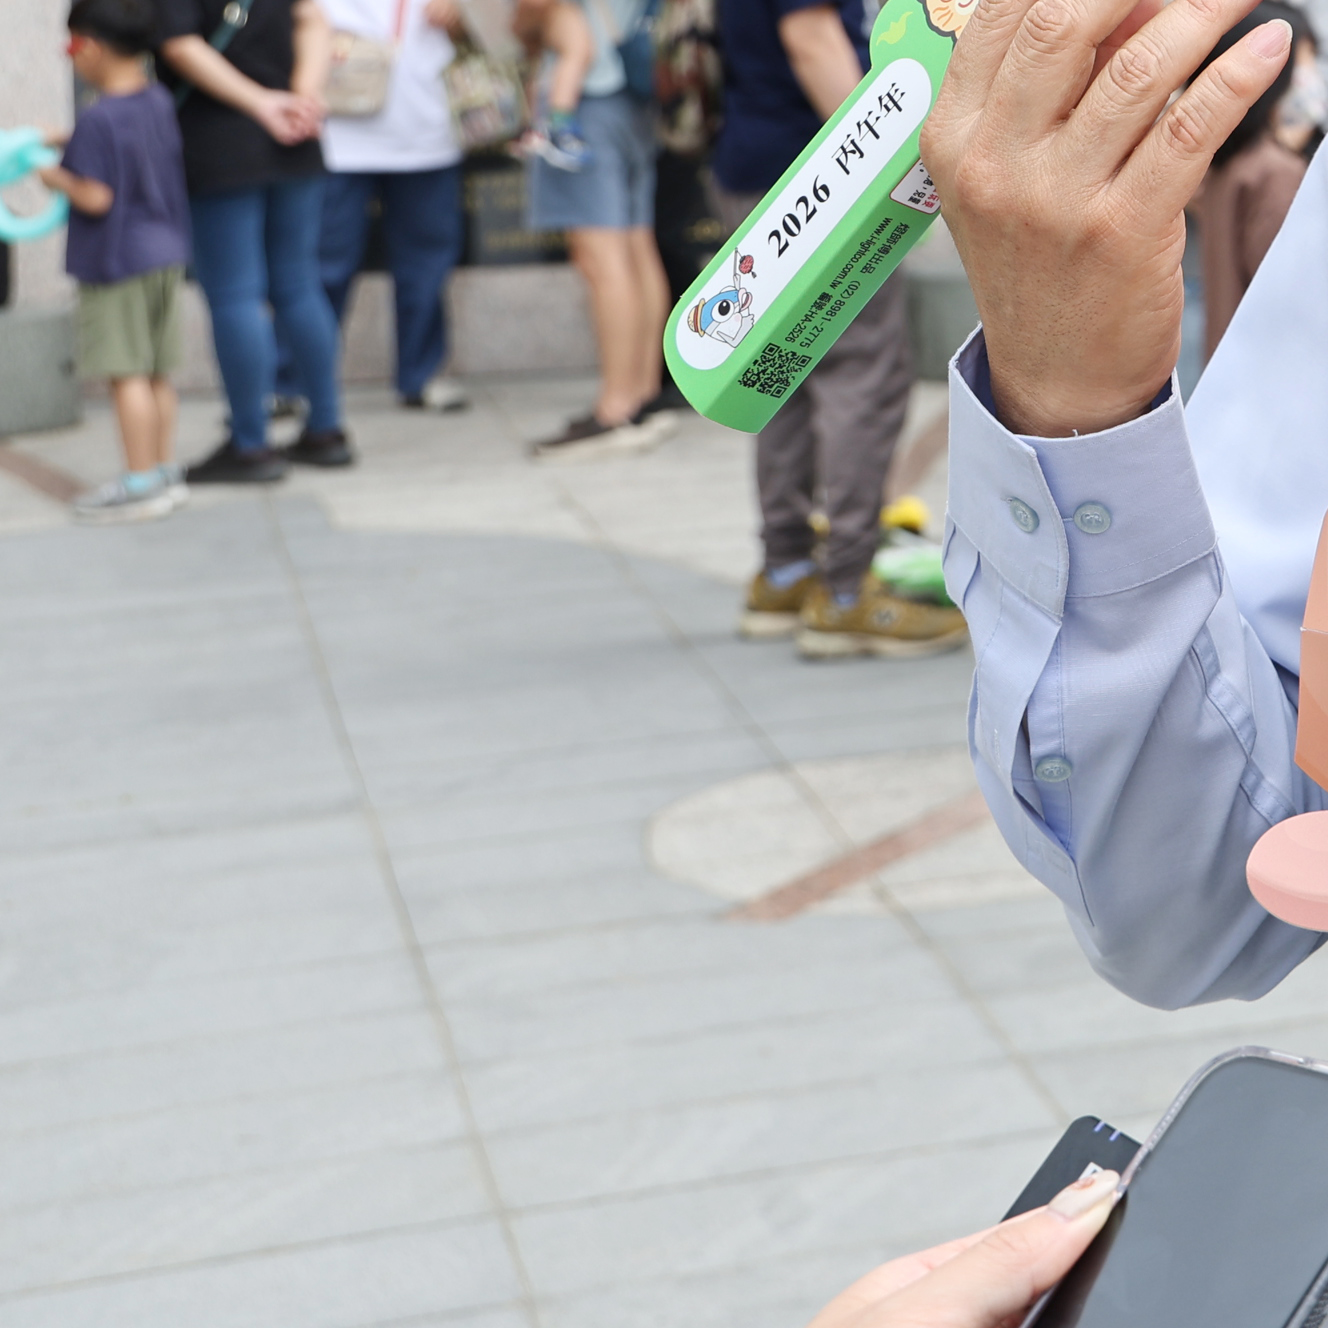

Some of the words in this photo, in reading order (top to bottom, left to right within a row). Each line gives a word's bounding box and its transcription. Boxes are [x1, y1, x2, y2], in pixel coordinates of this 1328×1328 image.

[767, 174, 831, 258] 2026
[831, 82, 906, 175] 丙午年
[829, 216, 893, 290] www.i-lightco.com.tw
[859, 221, 910, 275] 燈師傅出品
